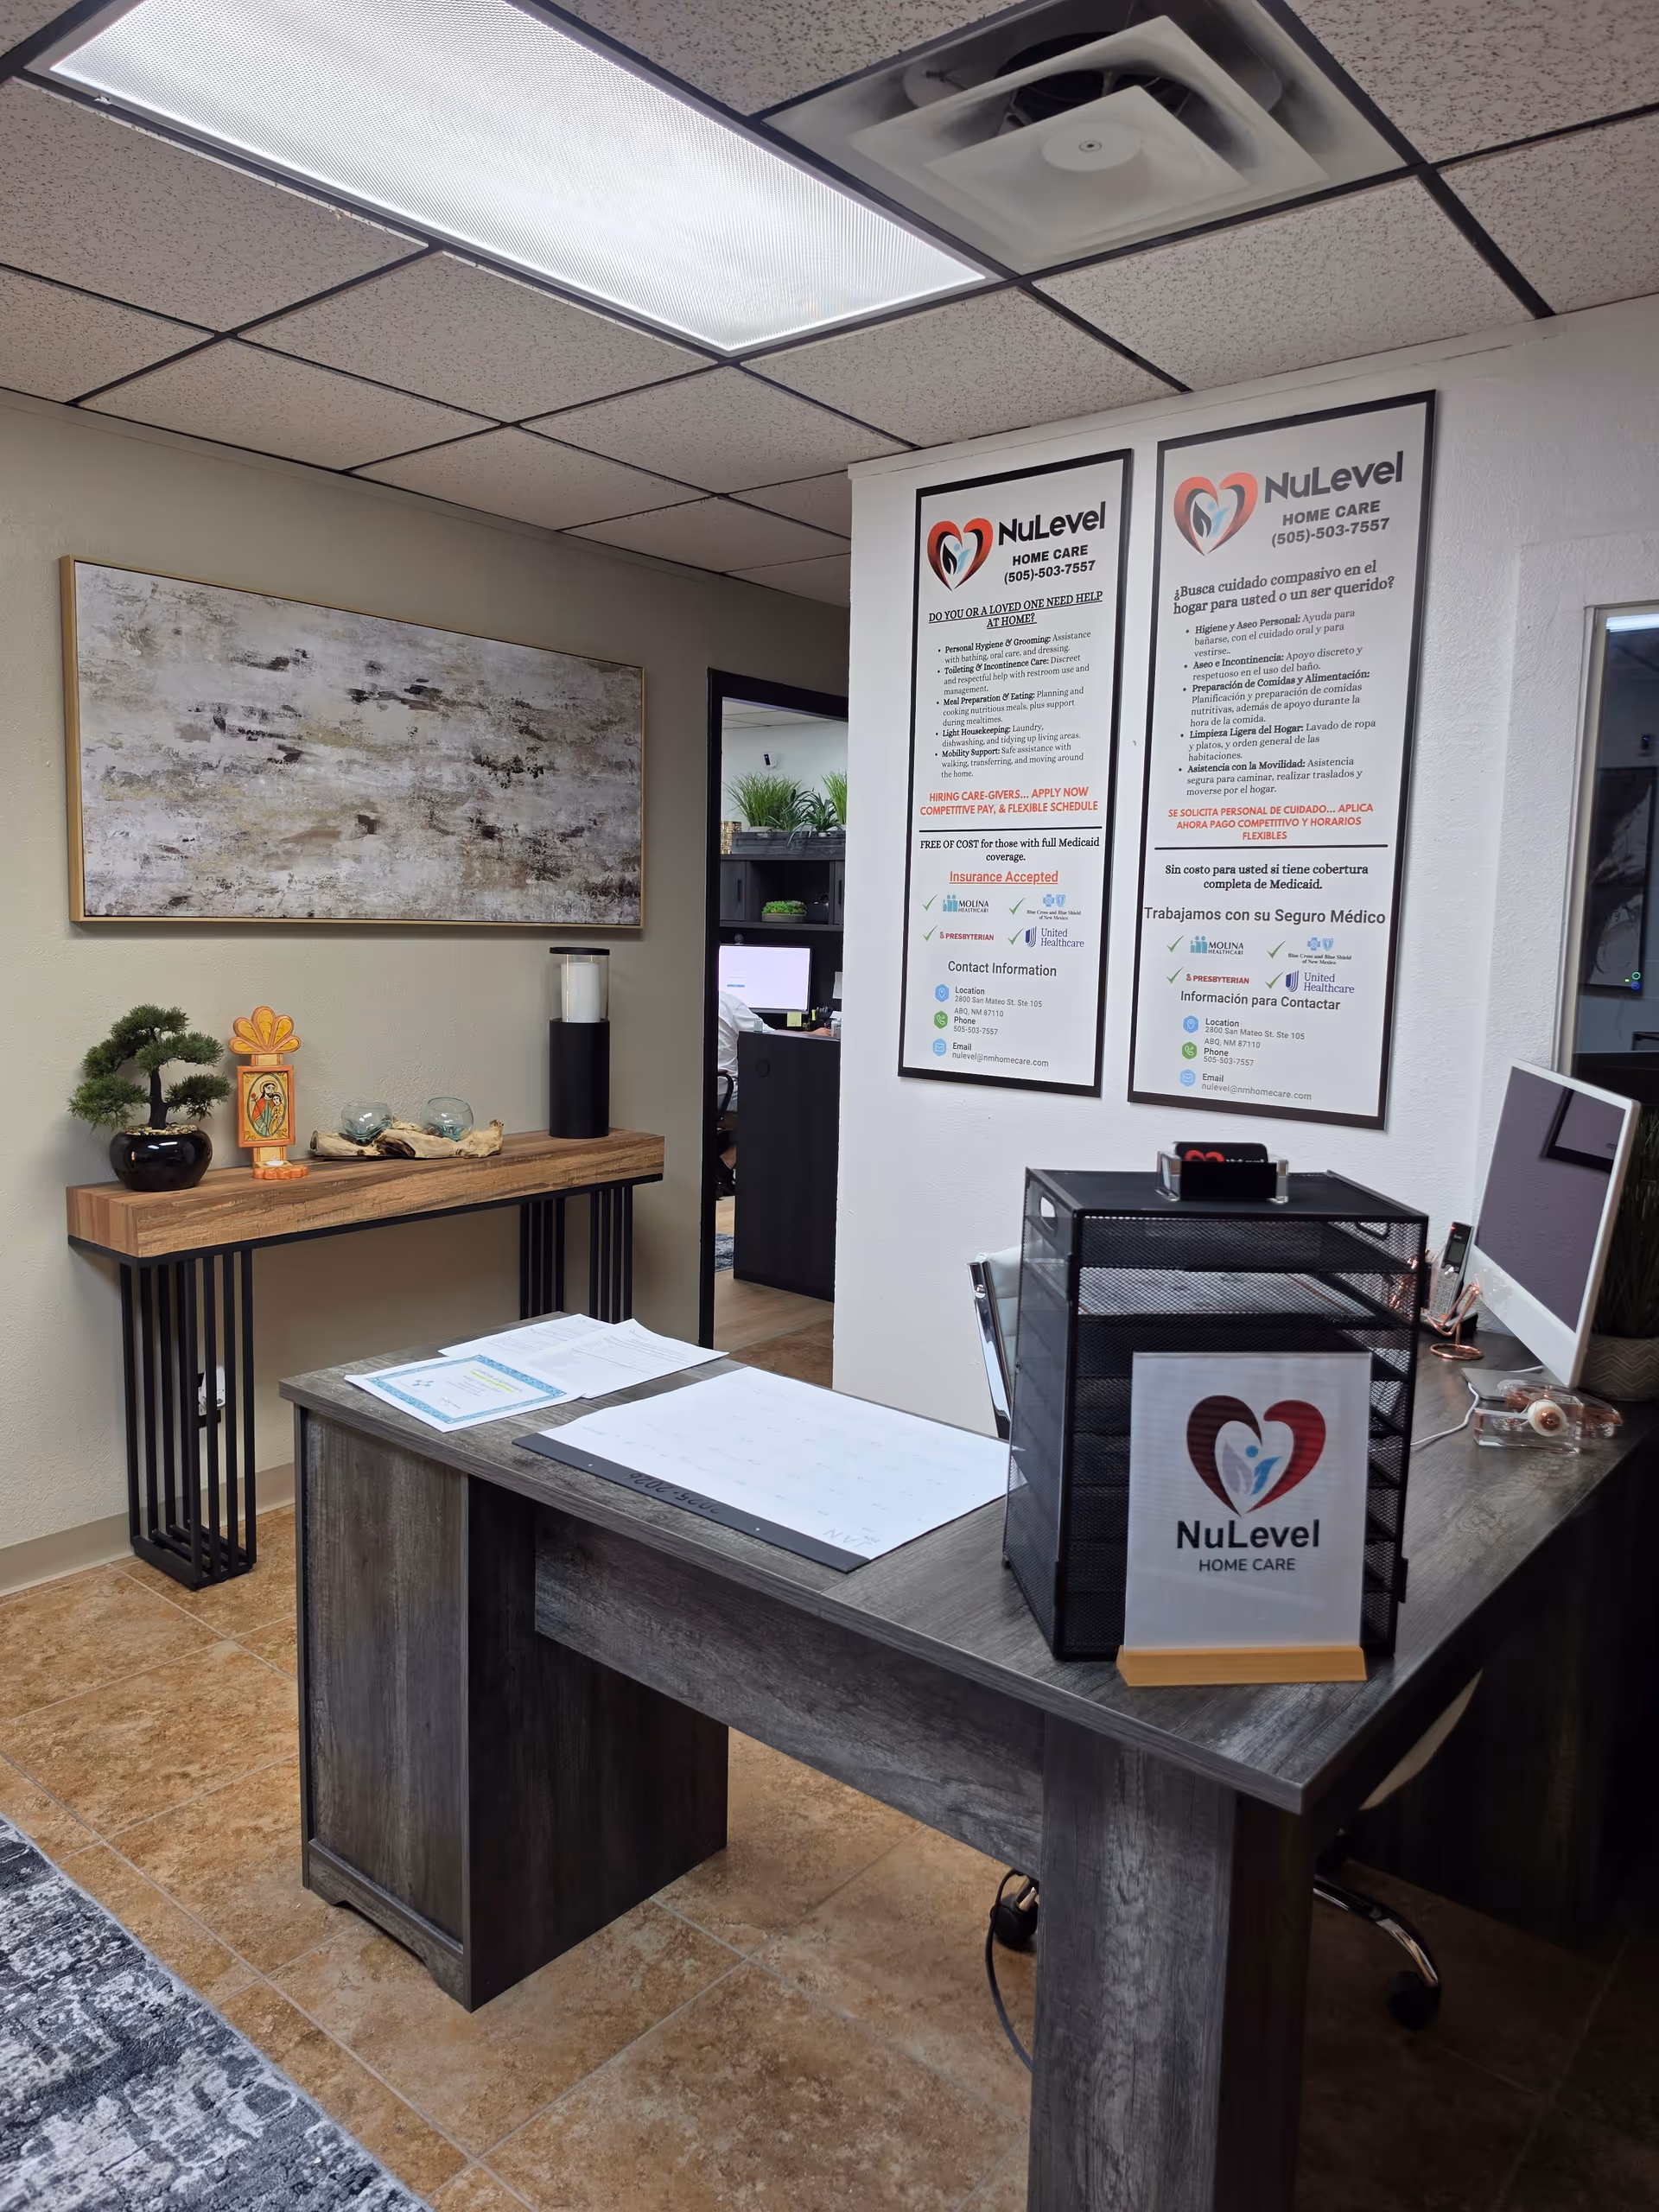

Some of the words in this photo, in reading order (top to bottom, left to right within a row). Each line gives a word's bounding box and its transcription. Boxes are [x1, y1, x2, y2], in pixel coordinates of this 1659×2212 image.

[1264, 449, 1404, 504] NuLevel
[1282, 507, 1330, 526] HOME
[1335, 499, 1381, 518] CARE
[998, 500, 1106, 546] NuLevel
[1271, 517, 1390, 548] (505)-503-7557
[1012, 550, 1049, 566] HOME
[1052, 543, 1089, 560] CARE
[1003, 559, 1096, 586] (505)-503-7557
[1173, 584, 1215, 601] ¿Busca
[1217, 575, 1268, 593] cuidado
[1270, 566, 1341, 590] compasivo
[1344, 565, 1361, 576] en
[1363, 559, 1377, 579] el
[1173, 601, 1209, 616] hogar
[1209, 598, 1238, 613] para
[1240, 589, 1276, 607] usted
[1289, 589, 1308, 601] un
[1310, 586, 1332, 598] ser
[1333, 575, 1395, 598] querido?
[928, 610, 943, 622] DO
[944, 607, 964, 620] YOU
[965, 606, 979, 617] OR
[988, 600, 1021, 614] LOVED
[1022, 597, 1045, 610] ONE
[1045, 594, 1073, 607] NEED
[1075, 589, 1103, 603] HELP
[986, 616, 999, 628] AT
[1001, 612, 1035, 626] HOME?
[944, 642, 974, 654] Personal
[975, 640, 1004, 652] Hygiene
[1013, 634, 1051, 646] Grooming:
[1052, 632, 1091, 642] Assistance
[1192, 679, 1243, 694] Preparación
[1244, 678, 1255, 688] de
[1256, 675, 1296, 687] Comidas
[1304, 669, 1370, 683] Alimentación:
[943, 696, 960, 706] Meal
[960, 694, 1001, 706] Preparation
[1010, 690, 1035, 701] Eating:
[1036, 688, 1069, 698] Planning
[1070, 685, 1084, 696] and
[1192, 691, 1245, 704] Planificación
[1254, 686, 1308, 702] preparación
[1310, 685, 1321, 695] de
[1323, 682, 1363, 693] comidas
[943, 707, 969, 716] cooking
[970, 704, 1005, 714] nutritious
[1006, 702, 1028, 711] meals,
[1029, 701, 1045, 711] plus
[1046, 699, 1075, 709] support
[942, 718, 965, 728] during
[966, 715, 1003, 725] mealtimes.
[942, 728, 960, 739] Light
[960, 725, 1011, 736] Housekeeping:
[1012, 722, 1044, 733] Laundry,
[941, 748, 970, 759] Mobility
[970, 747, 1001, 758] Support:
[1001, 745, 1016, 754] Safe
[1017, 745, 1053, 753] assistance
[1054, 742, 1071, 751] with
[1188, 751, 1243, 761] habitaciones.
[1186, 762, 1230, 773] Asistencia
[1248, 760, 1257, 770] la
[1258, 758, 1306, 770] Movilidad:
[1306, 756, 1354, 767] Asistencia
[929, 791, 960, 802] HIRING
[961, 789, 1029, 801] CARE-GIVERS...
[1031, 787, 1062, 798] APPLY
[1063, 786, 1089, 797] NOW
[919, 804, 976, 816] COMPETITIVE
[976, 804, 996, 815] PAY,
[1007, 802, 1048, 813] FLEXIBLE
[1049, 800, 1098, 811] SCHEDULE
[1167, 809, 1179, 817] SE
[1179, 807, 1219, 817] SOLICITA
[1220, 806, 1268, 816] PERSONAL
[1269, 805, 1281, 815] DE
[1282, 804, 1335, 814] CUIDADO...
[1338, 803, 1374, 813] APLICA
[1176, 820, 1208, 830] AHORA
[1210, 819, 1236, 829] PAGO
[1236, 817, 1300, 828] COMPETITIVO
[1310, 816, 1362, 826] HORARIOS
[919, 840, 942, 849] FREE
[943, 839, 955, 849] OF
[956, 839, 980, 849] COST
[980, 838, 994, 849] for
[994, 838, 1018, 849] those
[1019, 837, 1040, 848] with
[1041, 836, 1057, 848] full
[1058, 836, 1100, 848] Medicaid
[1242, 830, 1287, 841] FLEXIBLES
[985, 854, 1026, 863] coverage.
[949, 870, 1001, 884] Insurance
[1004, 870, 1058, 884] Accepted
[1165, 863, 1181, 874] Sin
[1183, 865, 1211, 874] costo
[1211, 866, 1236, 877] para
[1237, 863, 1268, 874] usted
[1269, 863, 1280, 874] si
[1281, 863, 1310, 874] tiene
[1312, 862, 1369, 874] cobertura
[1203, 877, 1252, 892] completa
[1253, 878, 1268, 889] de
[1268, 878, 1323, 889] Medicaid.
[1143, 906, 1221, 923] Trabajamos
[1224, 911, 1250, 921] con
[1254, 911, 1270, 921] su
[1274, 908, 1325, 925] Seguro
[1330, 909, 1386, 924] Médico
[945, 932, 995, 941] PRESBYTERIAN
[1040, 927, 1068, 938] United
[1040, 936, 1084, 948] Healthcare
[1208, 941, 1243, 951] MOLINA
[948, 960, 989, 973] Contact
[992, 962, 1057, 976] Information
[1192, 975, 1249, 984] PRESBYTERIAN
[1304, 971, 1335, 982] United
[955, 986, 985, 995] Location
[1303, 982, 1355, 994] Healthcare
[955, 995, 970, 1003] 2800
[1180, 990, 1249, 1005] Información
[1251, 996, 1277, 1007] para
[1281, 995, 1341, 1010] Contactar
[953, 1015, 976, 1025] Phone
[954, 1007, 969, 1016] ABQ,
[982, 1008, 1003, 1017] 87110
[953, 1025, 998, 1035] 505-503-7557
[952, 1041, 972, 1051] Email
[951, 1051, 1049, 1067] nulevel@nmhomecare.com
[1176, 1518, 1320, 1549] NuLevel
[1198, 1558, 1248, 1573] HOME
[1252, 1557, 1296, 1572] CARE
